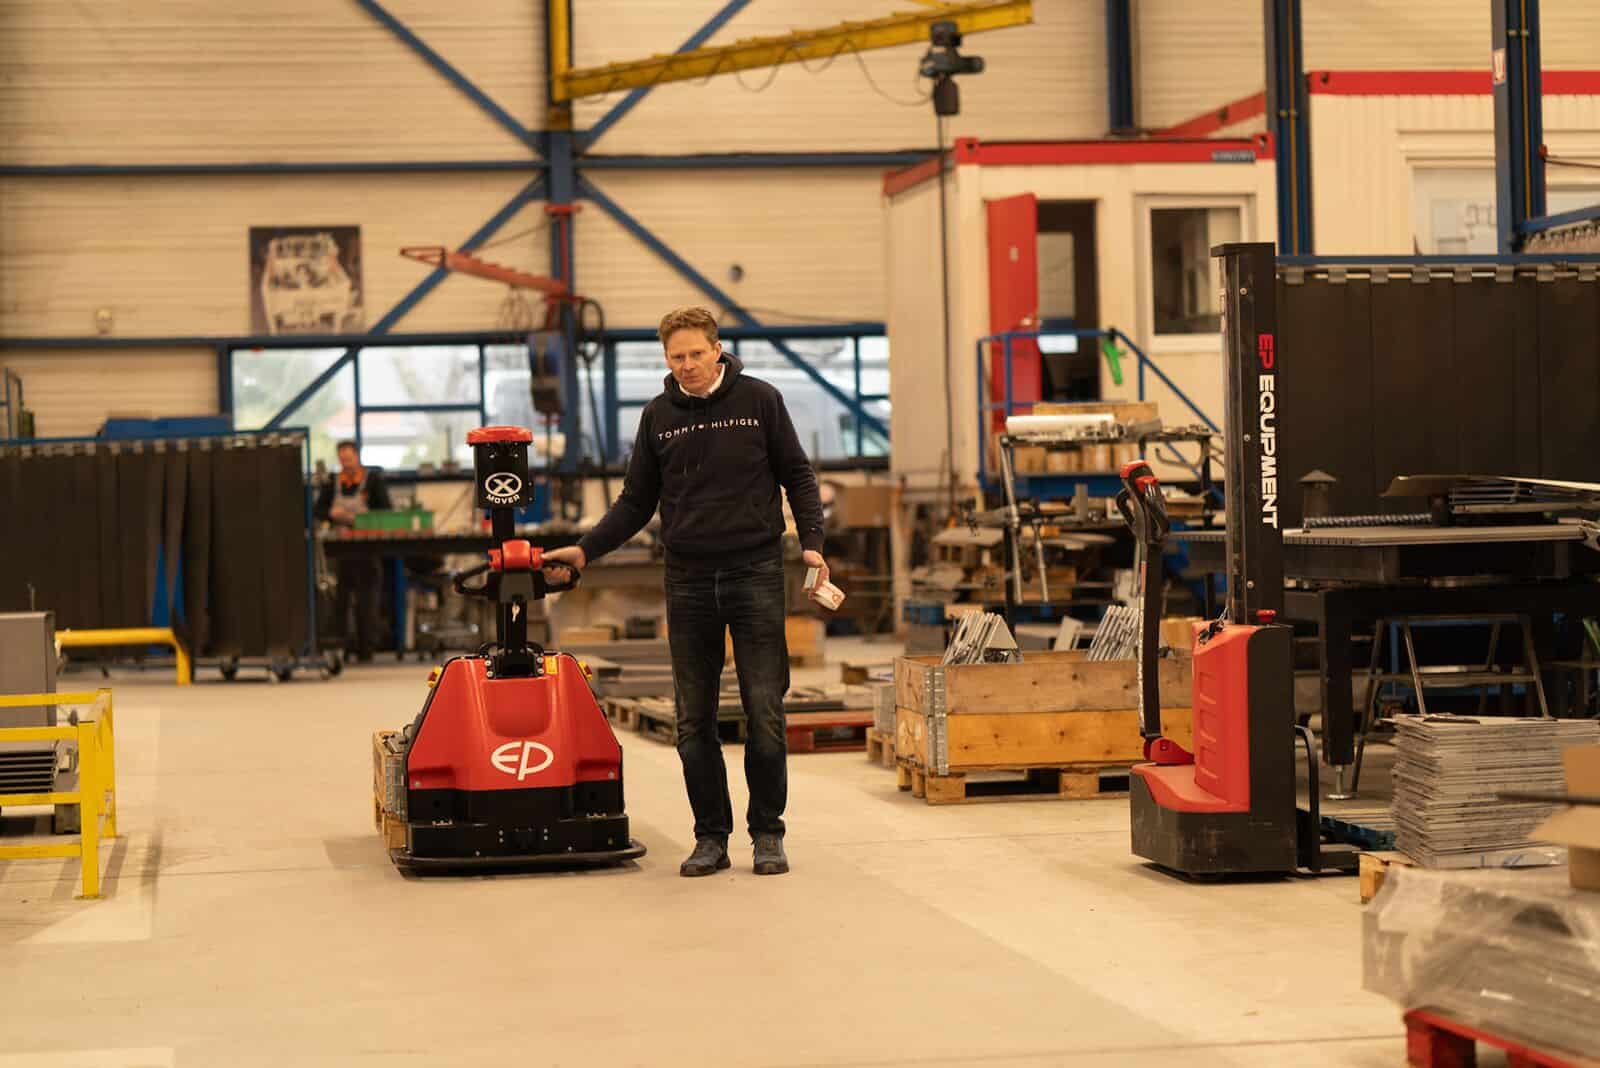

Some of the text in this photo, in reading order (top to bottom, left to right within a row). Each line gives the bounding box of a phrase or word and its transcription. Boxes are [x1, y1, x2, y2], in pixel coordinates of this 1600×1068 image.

[711, 418, 760, 429] HILFIGER
[1258, 333, 1278, 529] EP EQUIPMENT
[486, 493, 521, 505] MOVER
[490, 740, 554, 781] EP
